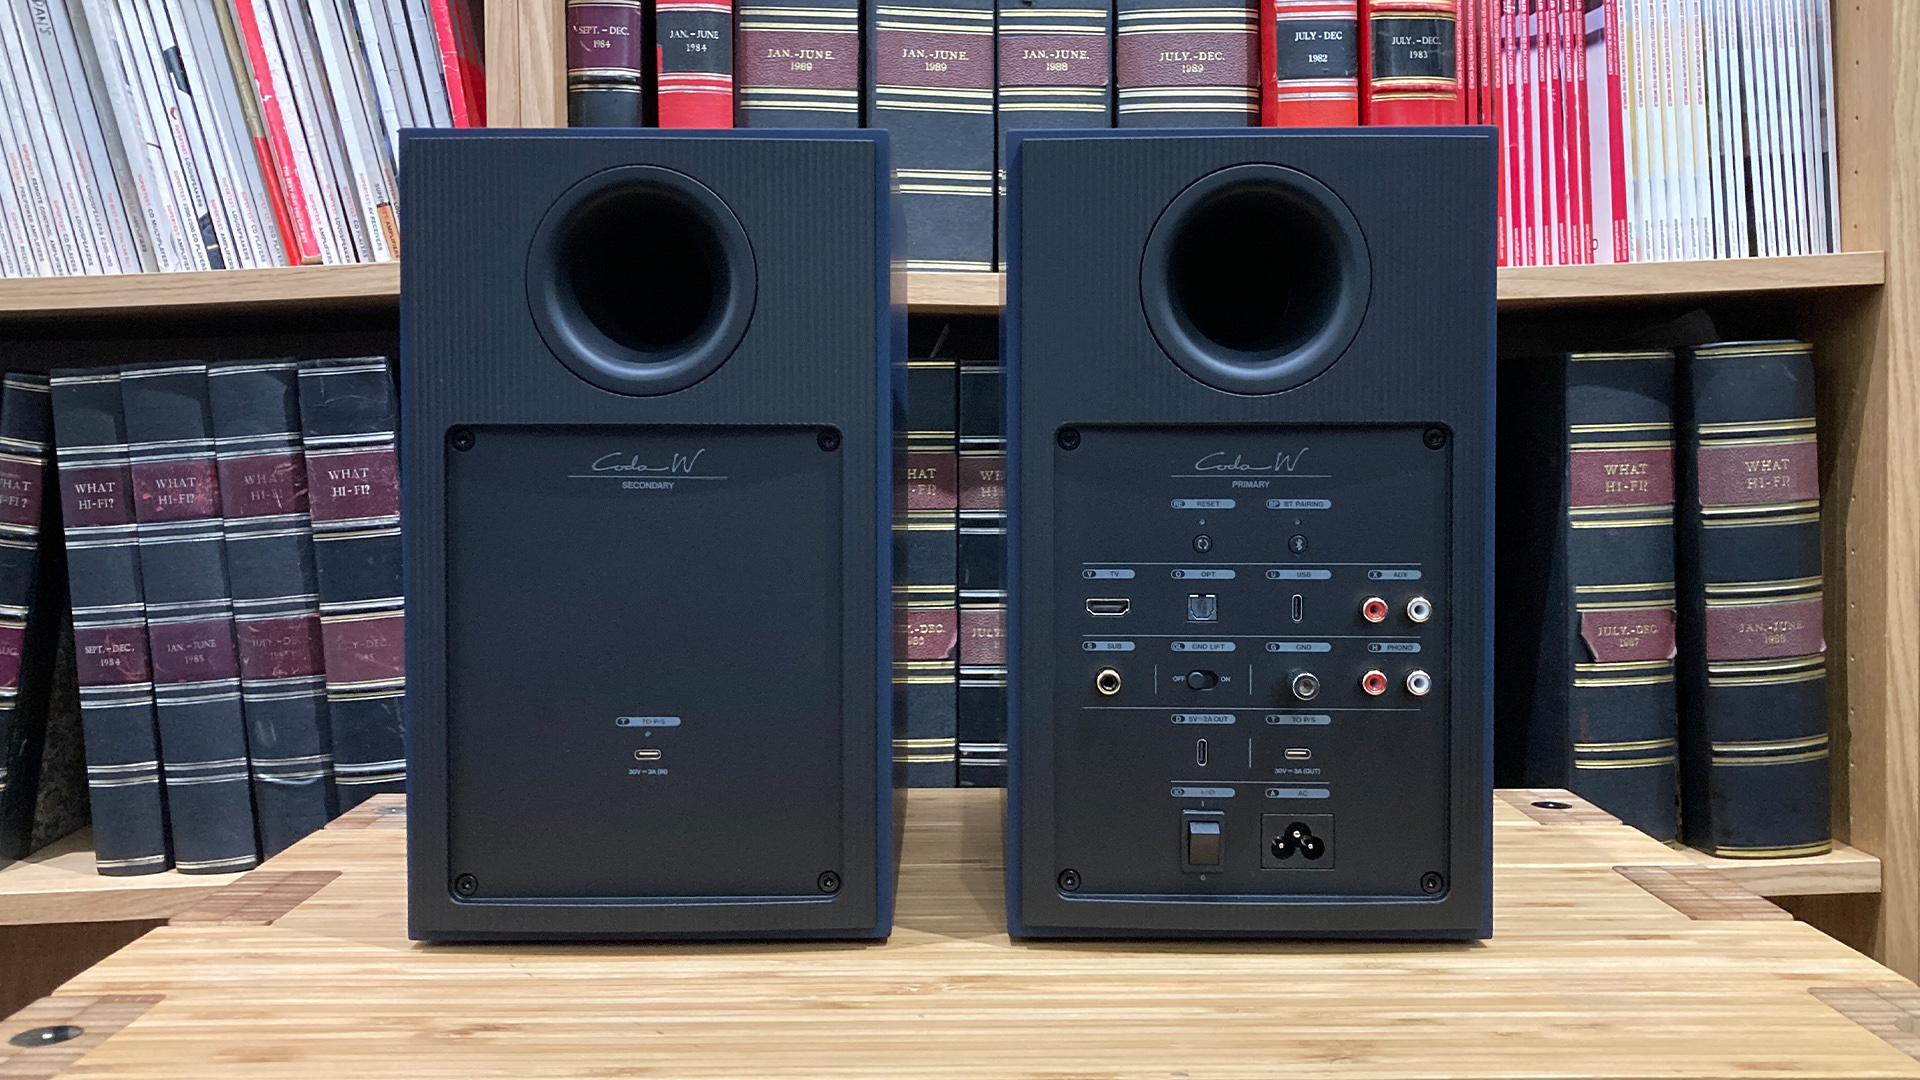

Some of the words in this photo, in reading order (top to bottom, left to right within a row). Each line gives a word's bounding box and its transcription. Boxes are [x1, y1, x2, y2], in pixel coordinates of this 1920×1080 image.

[593, 40, 611, 48] 1984
[686, 43, 708, 52] 1984
[1308, 54, 1328, 63] 1982
[1409, 50, 1428, 59] 1983
[790, 62, 813, 71] 1989
[925, 62, 948, 72] 1989
[1046, 62, 1068, 71] 1988
[1182, 64, 1204, 73] 1989
[592, 452, 669, 472] Coda
[671, 448, 706, 473] W
[1194, 452, 1272, 471] Coda
[1274, 447, 1310, 472] W
[1604, 464, 1648, 476] WHAT
[1744, 458, 1790, 472] WHAT
[328, 468, 370, 480] WHAT
[908, 468, 937, 480] HAT
[74, 482, 116, 494] WHAT
[156, 477, 196, 489] WHAT
[622, 482, 674, 490] SECONDARY
[1232, 480, 1270, 488] PRIMARY
[1605, 480, 1648, 492] HI-FI?
[1746, 476, 1790, 490] HI-FI?
[332, 484, 370, 497] HI-FI?
[78, 498, 114, 510] HI-FI?
[158, 494, 195, 506] HI-FI?
[1196, 500, 1220, 508] RESET
[908, 636, 924, 646] 989
[100, 658, 122, 666] 1984
[184, 654, 205, 664] 1985
